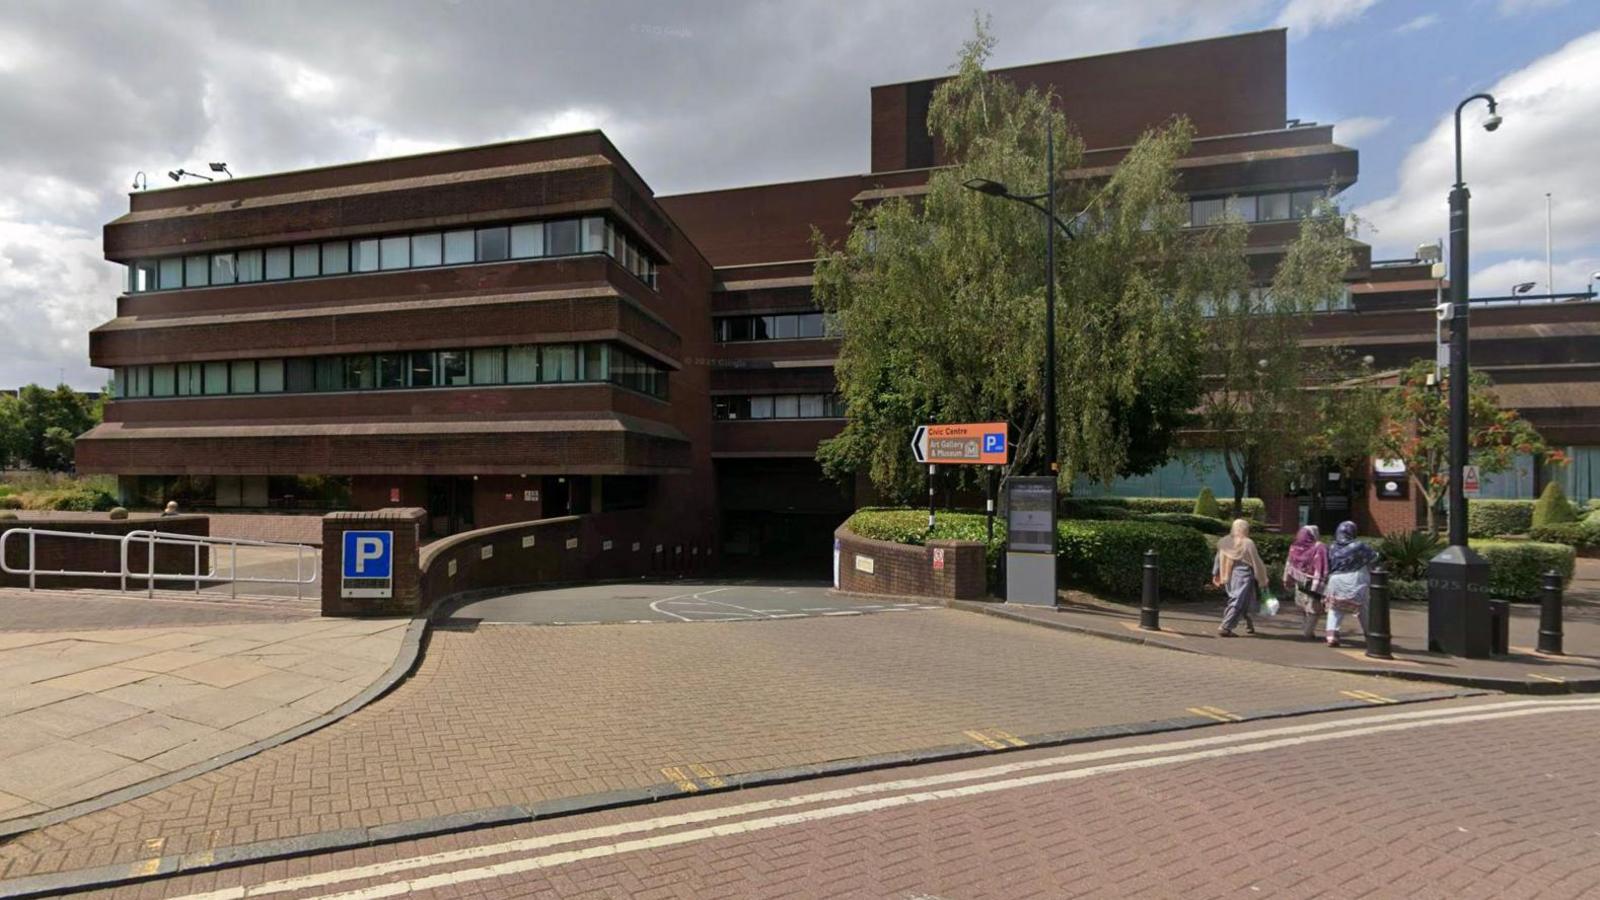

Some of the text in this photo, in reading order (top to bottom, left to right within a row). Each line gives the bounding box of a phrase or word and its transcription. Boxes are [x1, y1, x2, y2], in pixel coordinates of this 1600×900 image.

[928, 427, 968, 436] Civic Centre
[930, 440, 964, 449] Art Gallery
[986, 435, 997, 451] P
[937, 449, 963, 457] Museum
[355, 536, 384, 573] P
